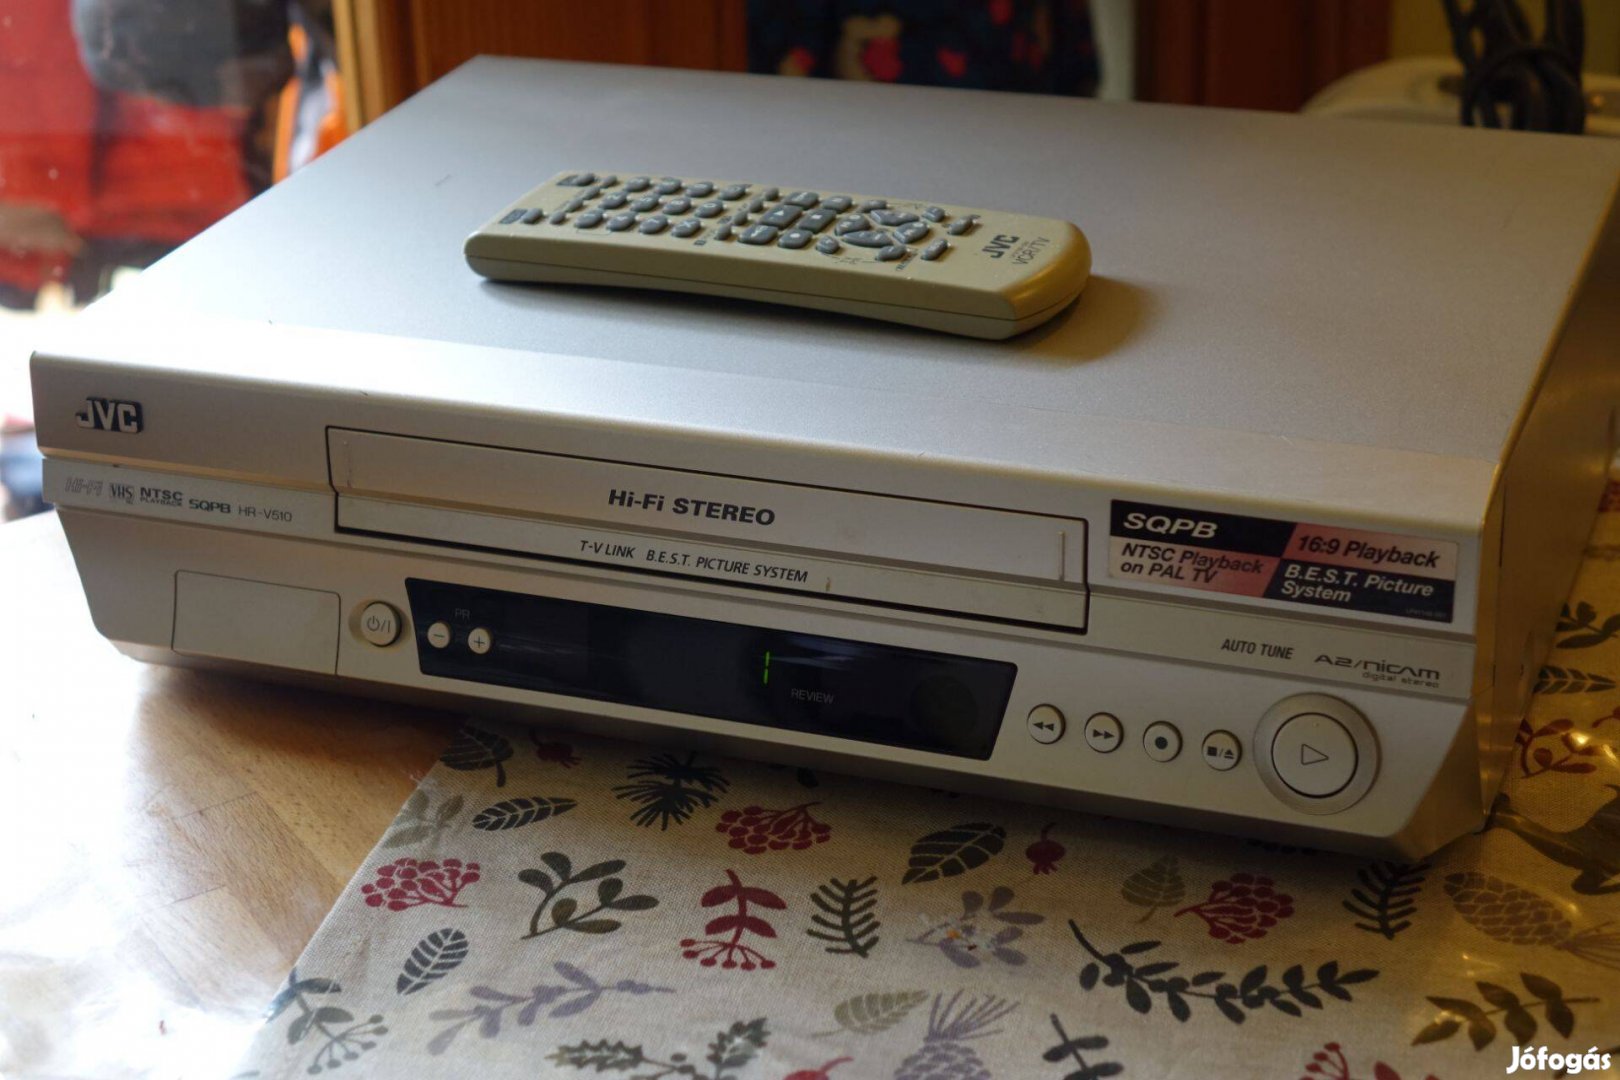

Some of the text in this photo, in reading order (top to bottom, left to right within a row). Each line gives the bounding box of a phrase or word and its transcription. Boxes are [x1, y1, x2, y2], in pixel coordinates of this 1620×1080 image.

[981, 234, 1020, 259] JVC
[76, 397, 144, 434] JVC
[140, 487, 183, 501] NTSC
[189, 500, 232, 514] SQPB
[238, 504, 293, 522] HR-V510
[608, 489, 775, 526] Hi-Fi STEREO
[1123, 512, 1219, 539] SQPB
[605, 543, 637, 559] LINK
[646, 549, 691, 567] B.E.S.T.
[696, 556, 751, 575] PICTURE
[753, 564, 808, 583] SYSTEM
[1121, 543, 1264, 574] NTSC Playback
[1298, 535, 1441, 569] 16:9 Playback
[1120, 561, 1219, 584] on PAL TV
[1284, 564, 1435, 597] B.E.S.T. Picture
[1280, 580, 1352, 603] System
[1220, 638, 1294, 660] AUTO TUNE
[790, 688, 835, 704] REVIEW
[1400, 678, 1440, 689] stereo
